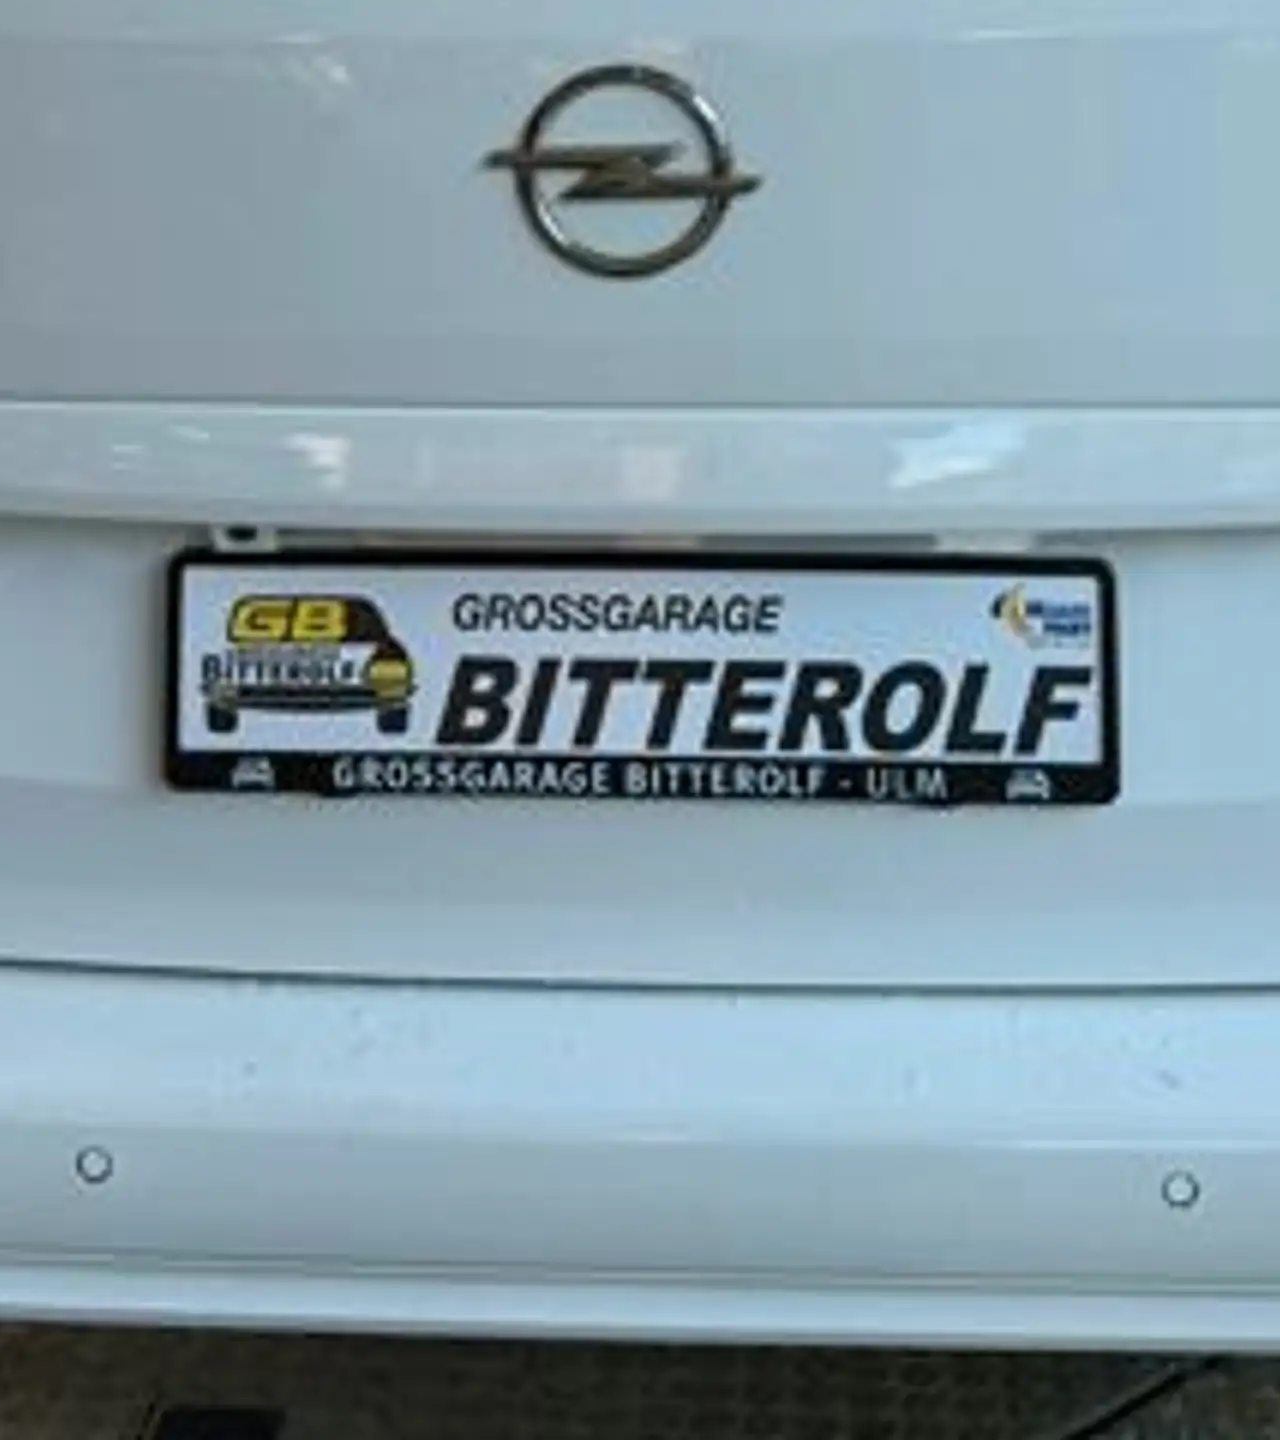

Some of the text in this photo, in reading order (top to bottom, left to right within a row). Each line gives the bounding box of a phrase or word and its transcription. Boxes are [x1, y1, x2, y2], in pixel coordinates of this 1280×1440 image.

[233, 598, 347, 639] GB
[453, 593, 784, 632] GROSSGARAGE
[436, 656, 1092, 754] BITTEROLF
[332, 757, 612, 795] GROSSGARAGE
[623, 762, 826, 796] BITTEROLF
[863, 766, 949, 800] ULM
